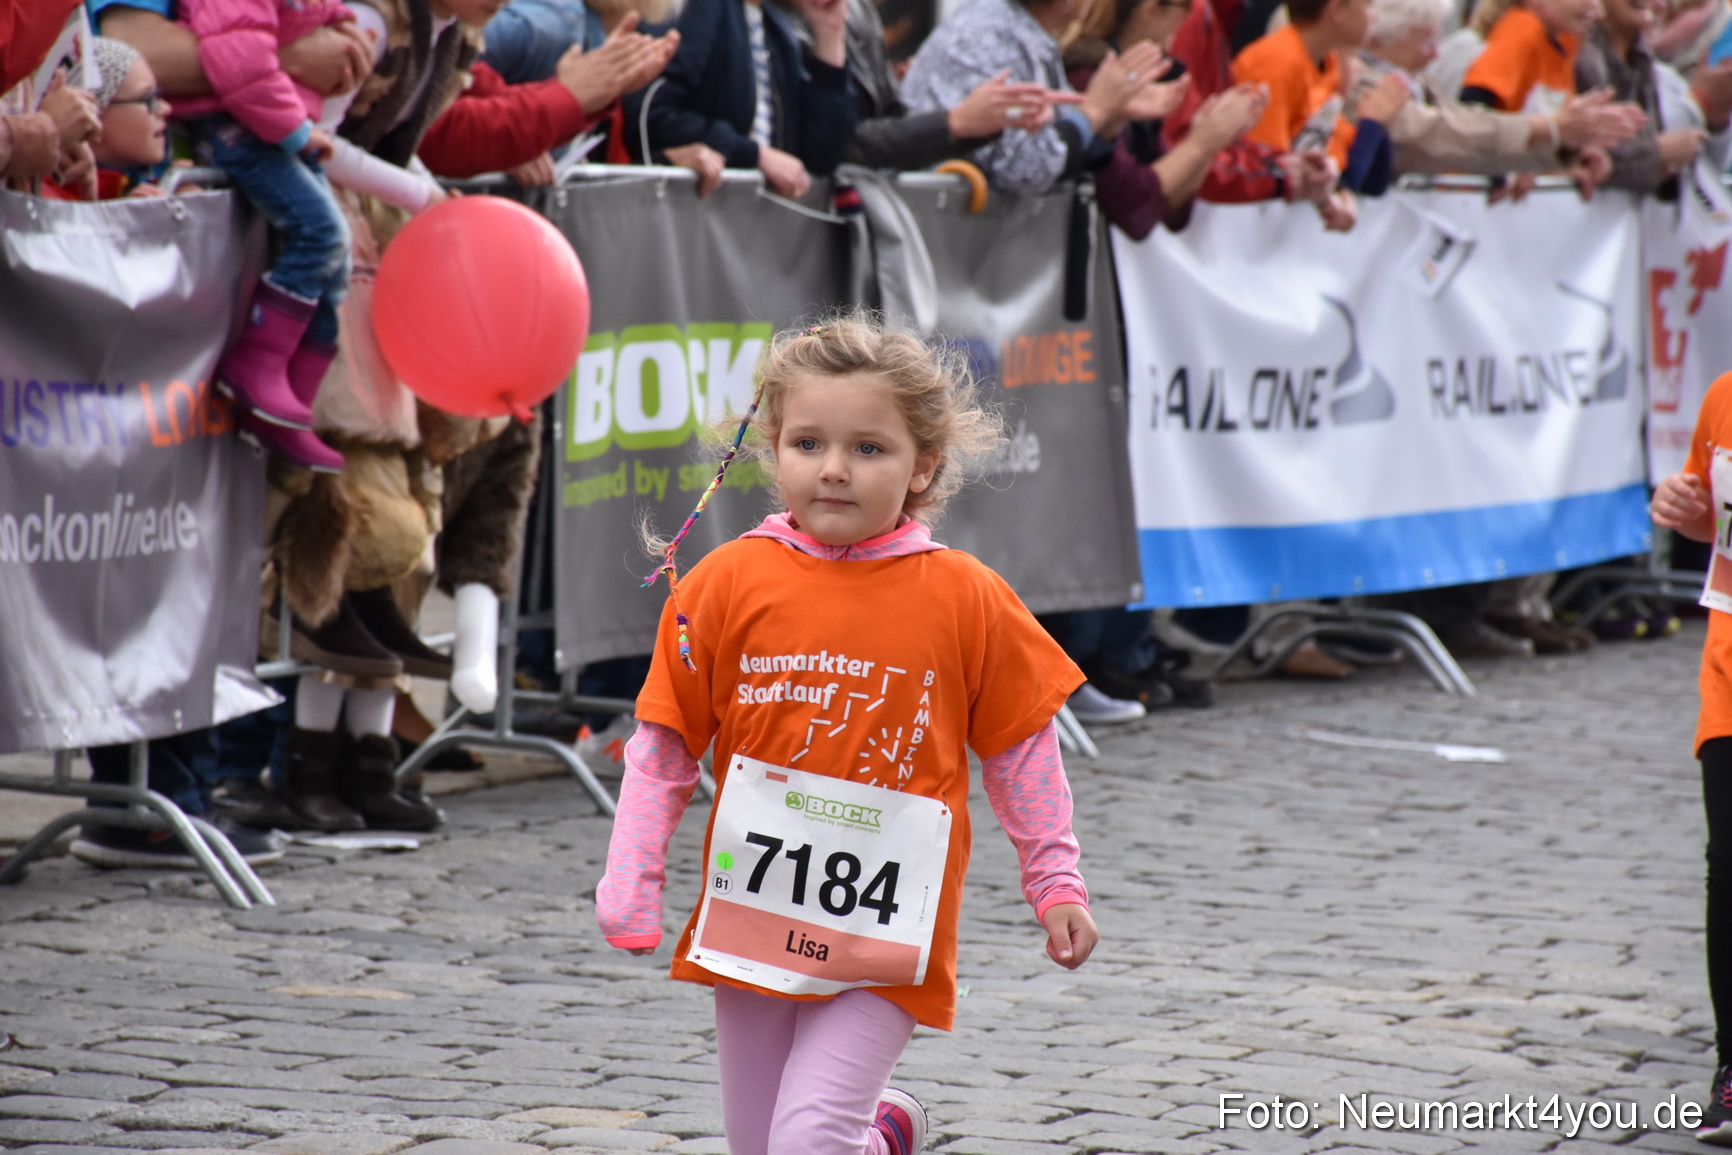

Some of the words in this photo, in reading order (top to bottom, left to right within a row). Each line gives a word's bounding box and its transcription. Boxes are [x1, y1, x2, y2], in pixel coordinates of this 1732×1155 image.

[573, 337, 764, 445] BOCK
[740, 650, 875, 678] Neumarkter
[738, 681, 839, 710] Stadtlauf
[805, 795, 883, 828] BOCK
[828, 818, 835, 826] by
[836, 821, 854, 830] smart
[854, 824, 881, 835] concepts
[715, 876, 729, 891] B1
[745, 831, 900, 925] 7184
[785, 930, 829, 962] Lisa
